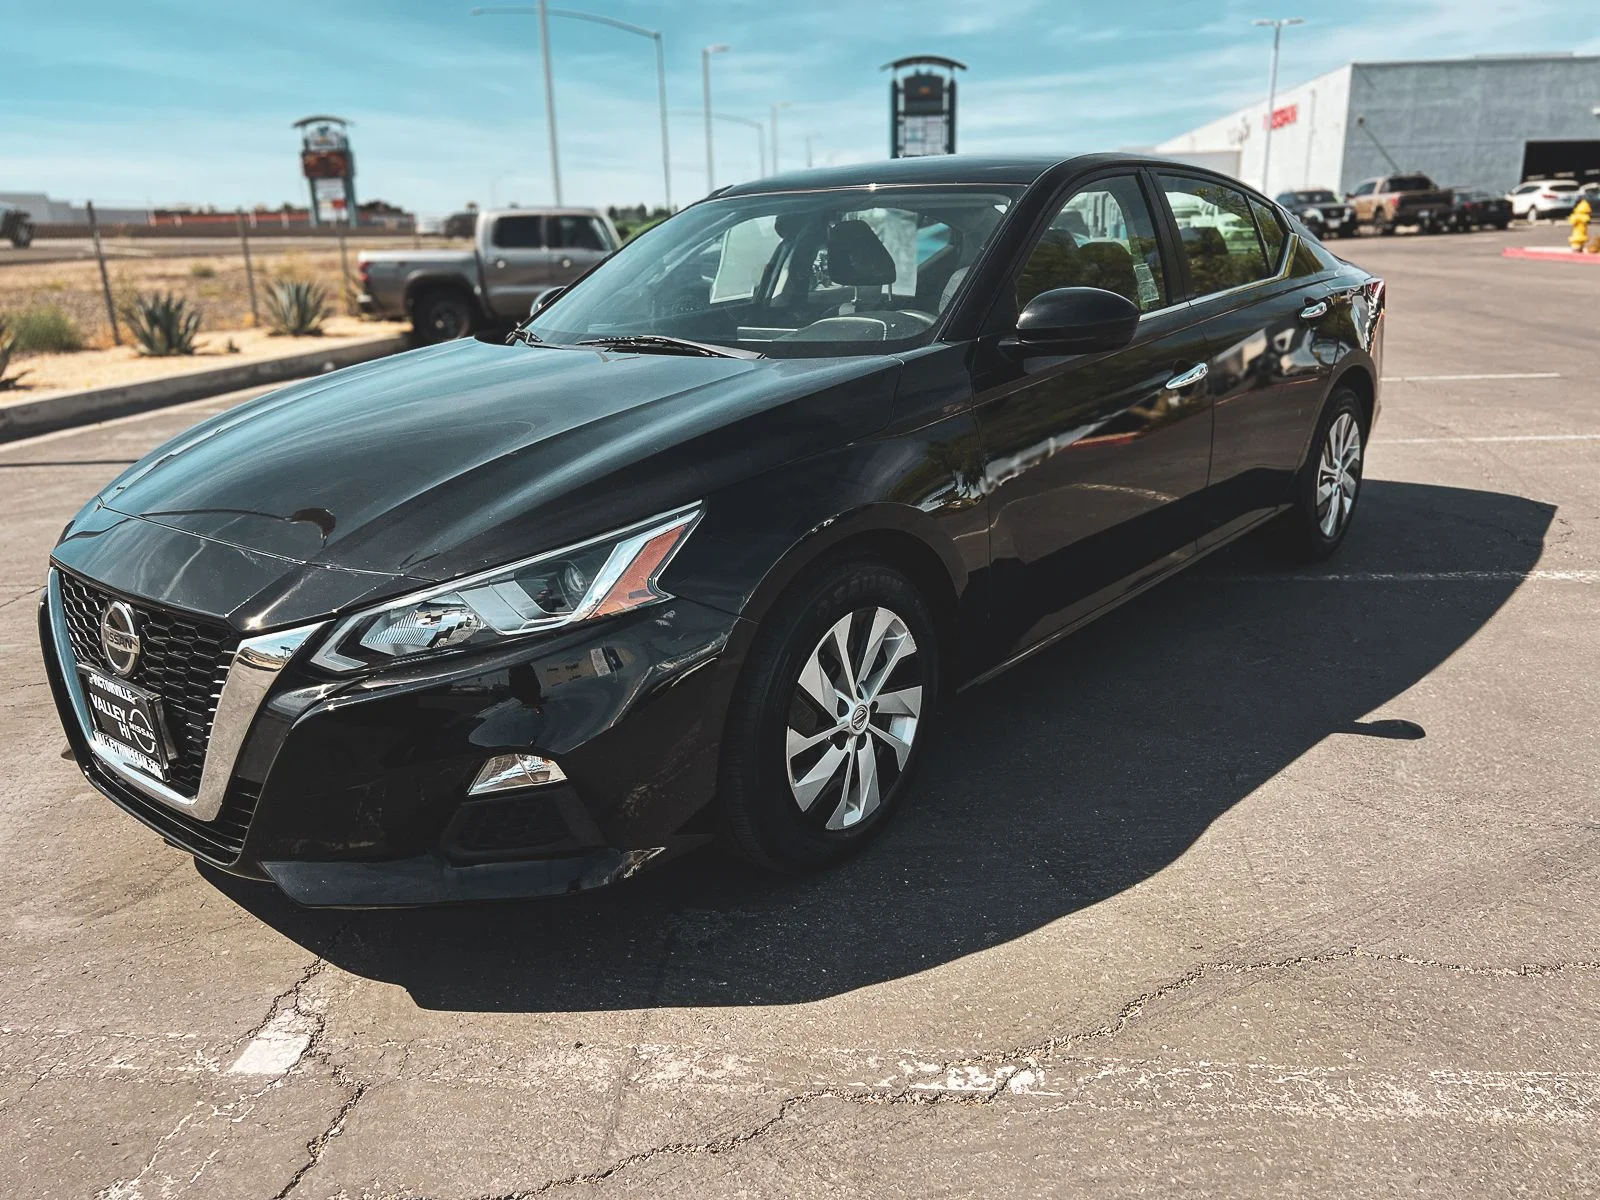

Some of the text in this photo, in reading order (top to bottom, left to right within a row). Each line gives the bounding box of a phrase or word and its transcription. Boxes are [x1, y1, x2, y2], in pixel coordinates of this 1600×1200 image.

[90, 692, 126, 723] VALLEY
[118, 722, 132, 741] HI
[128, 722, 155, 741] NISSAN
